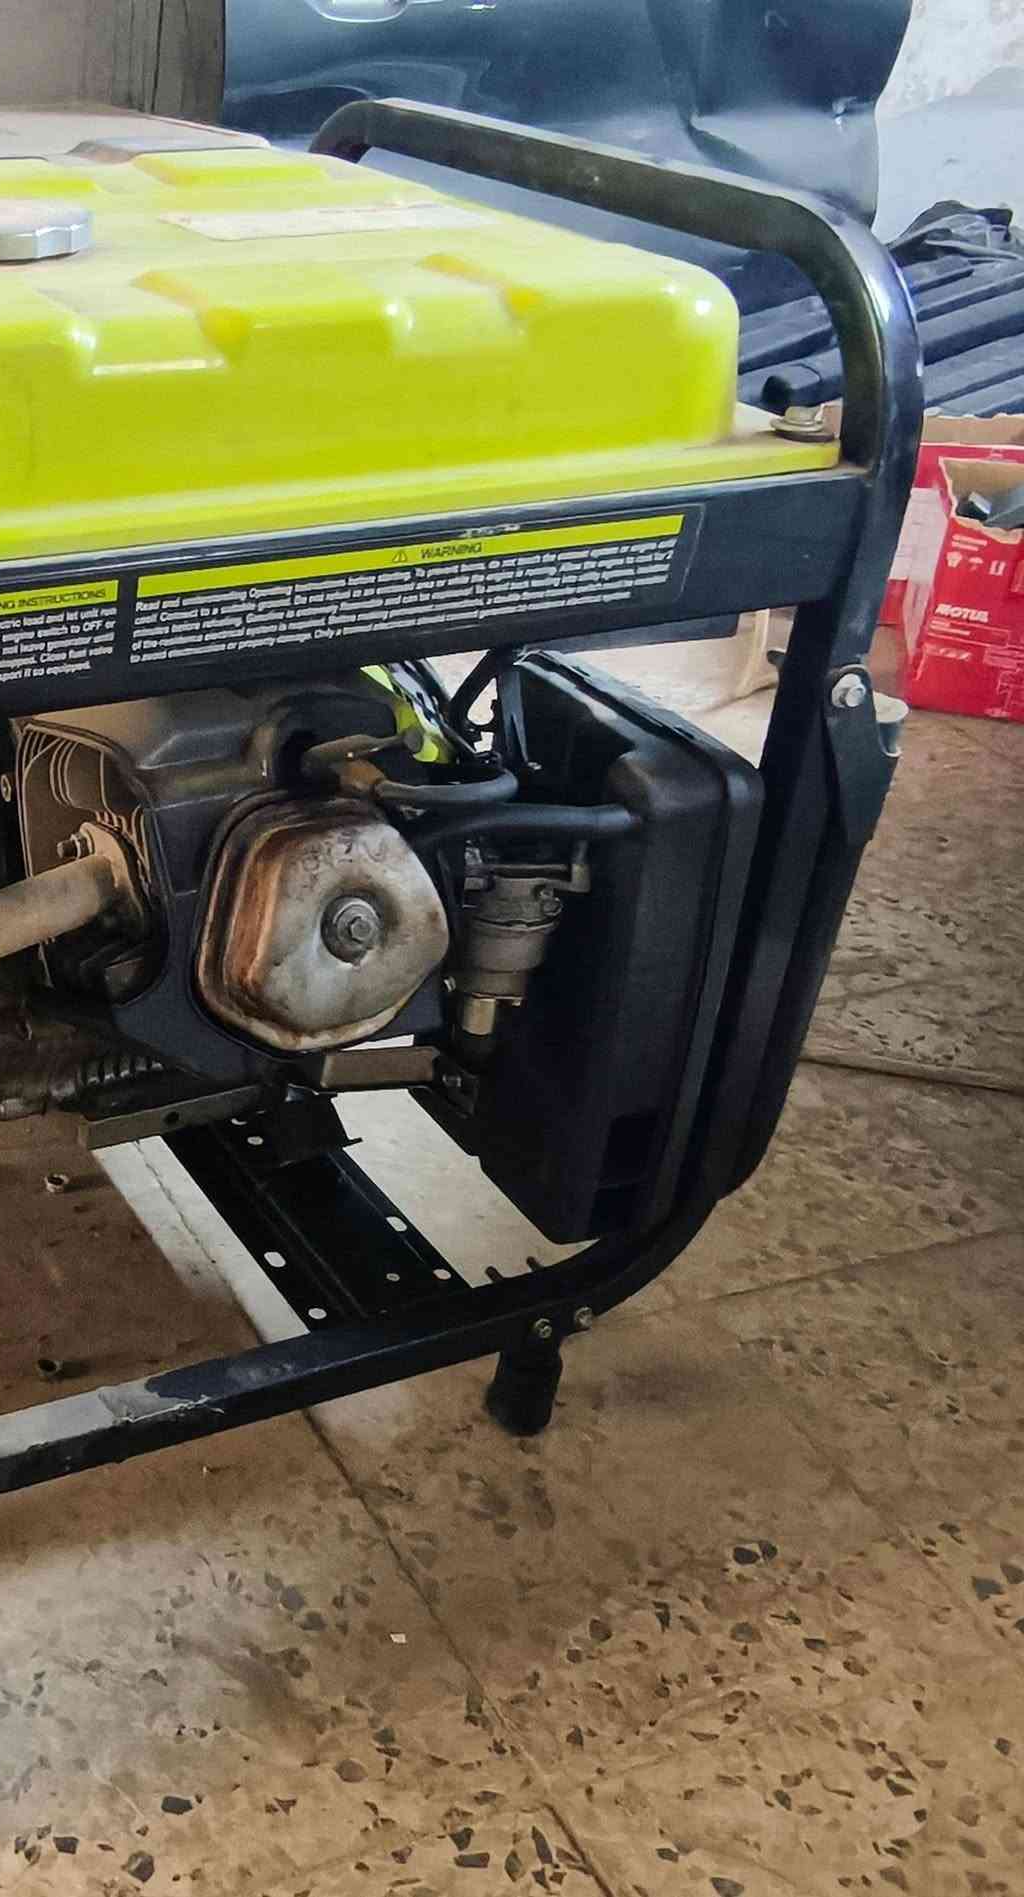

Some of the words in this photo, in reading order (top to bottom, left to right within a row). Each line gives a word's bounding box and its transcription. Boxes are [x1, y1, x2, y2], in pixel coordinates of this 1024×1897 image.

[420, 542, 481, 558] WARNING
[17, 588, 105, 607] INSTRUCTIONS
[70, 624, 80, 633] to
[82, 620, 102, 632] OFF
[104, 620, 115, 629] or
